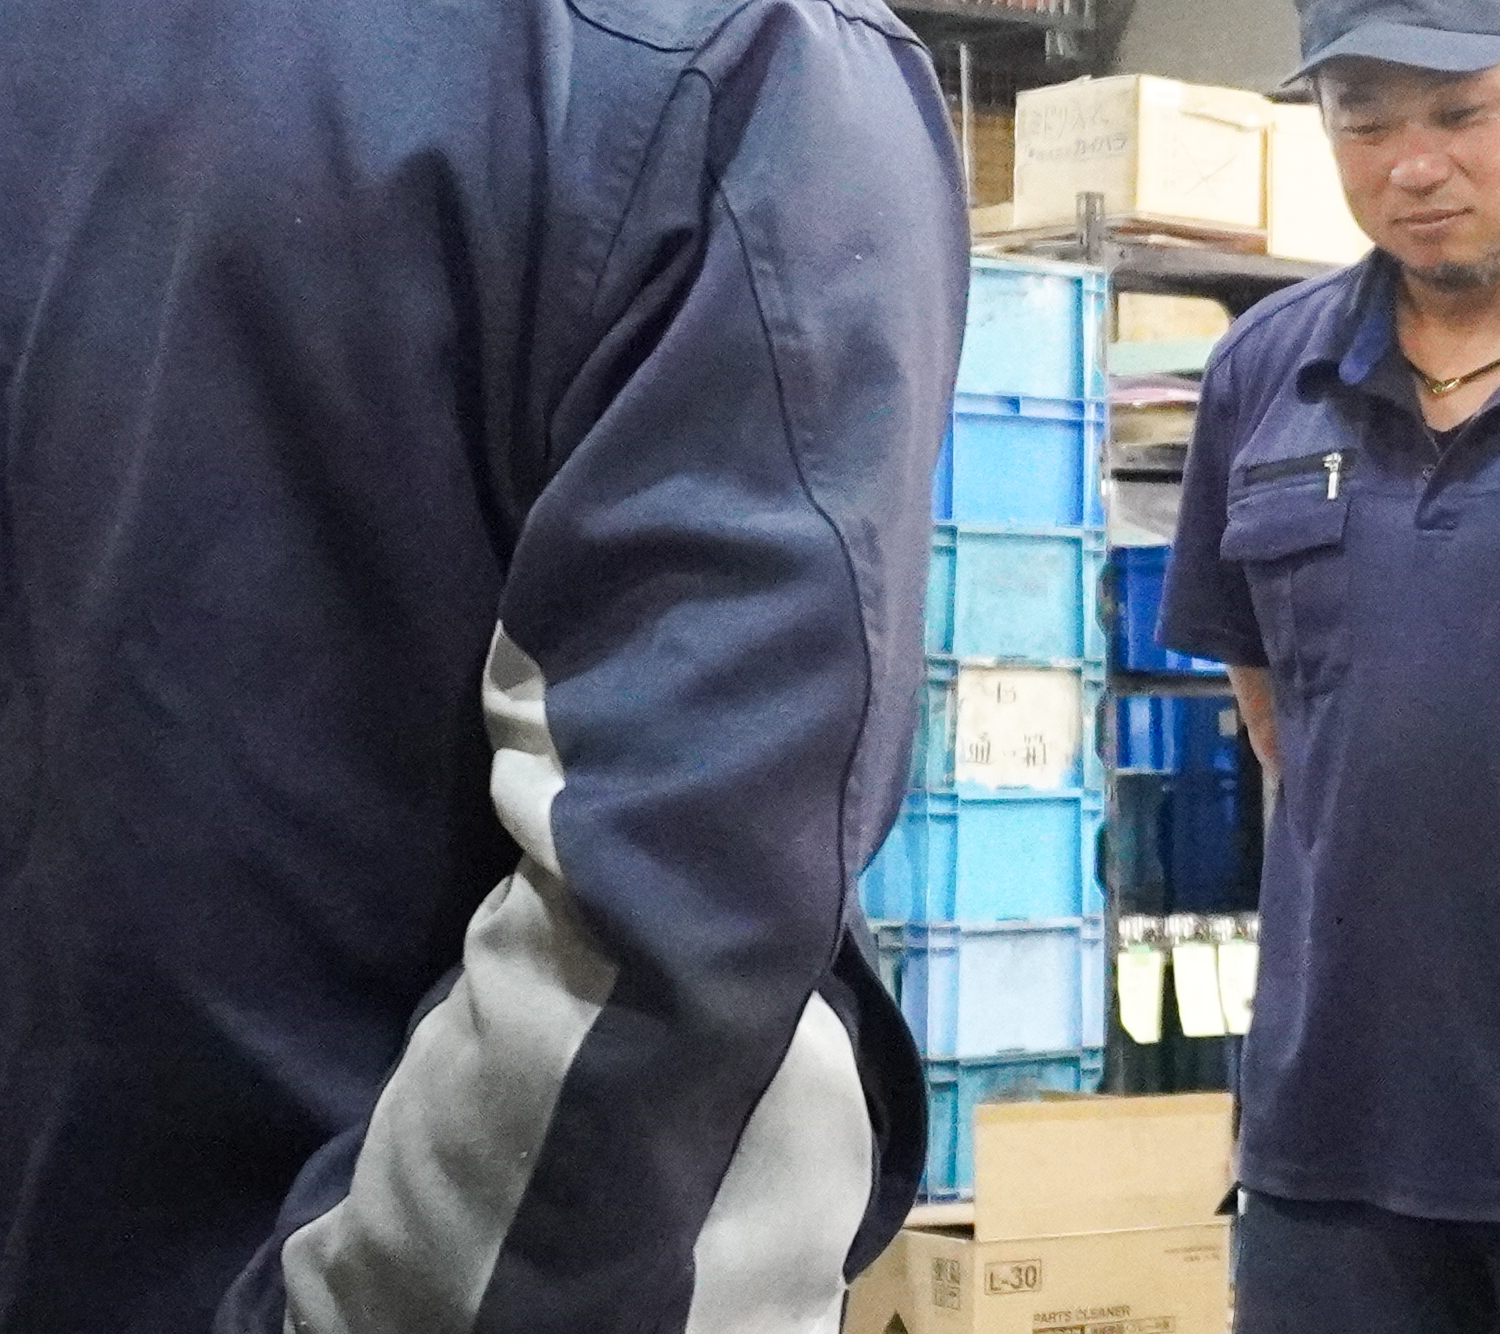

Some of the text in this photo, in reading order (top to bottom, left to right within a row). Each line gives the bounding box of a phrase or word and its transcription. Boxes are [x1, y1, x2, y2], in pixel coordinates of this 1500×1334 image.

[989, 1265, 1037, 1291] L-30
[1033, 1304, 1131, 1323] PARTS CLEANER
